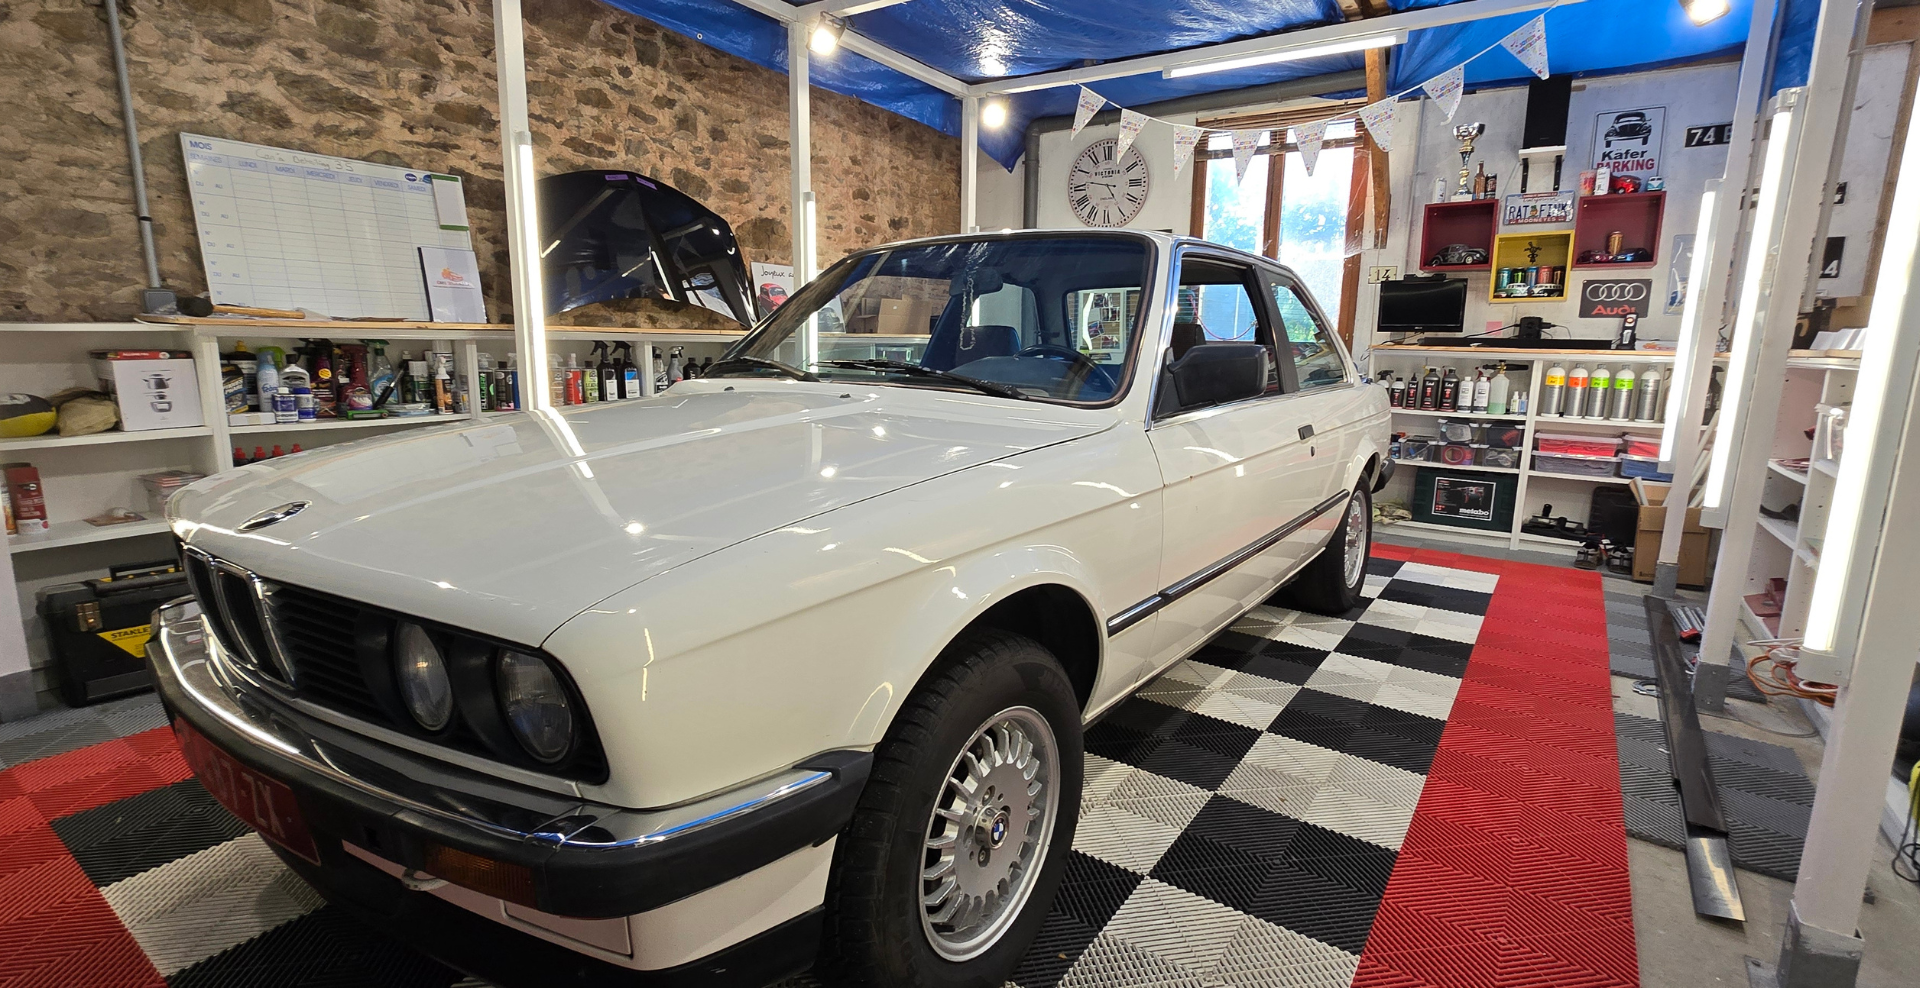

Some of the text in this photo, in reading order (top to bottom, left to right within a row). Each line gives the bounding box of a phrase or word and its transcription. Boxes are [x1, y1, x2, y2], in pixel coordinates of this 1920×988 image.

[1690, 128, 1716, 146] 74
[189, 140, 212, 150] MOIS
[1601, 148, 1648, 162] Käfer
[306, 170, 336, 180] MERCREDI
[374, 180, 399, 188] VENDREDI
[1509, 205, 1530, 219] RAT
[761, 266, 786, 279] Joyeux
[1591, 304, 1636, 315] Audi
[110, 627, 150, 639] STANLE
